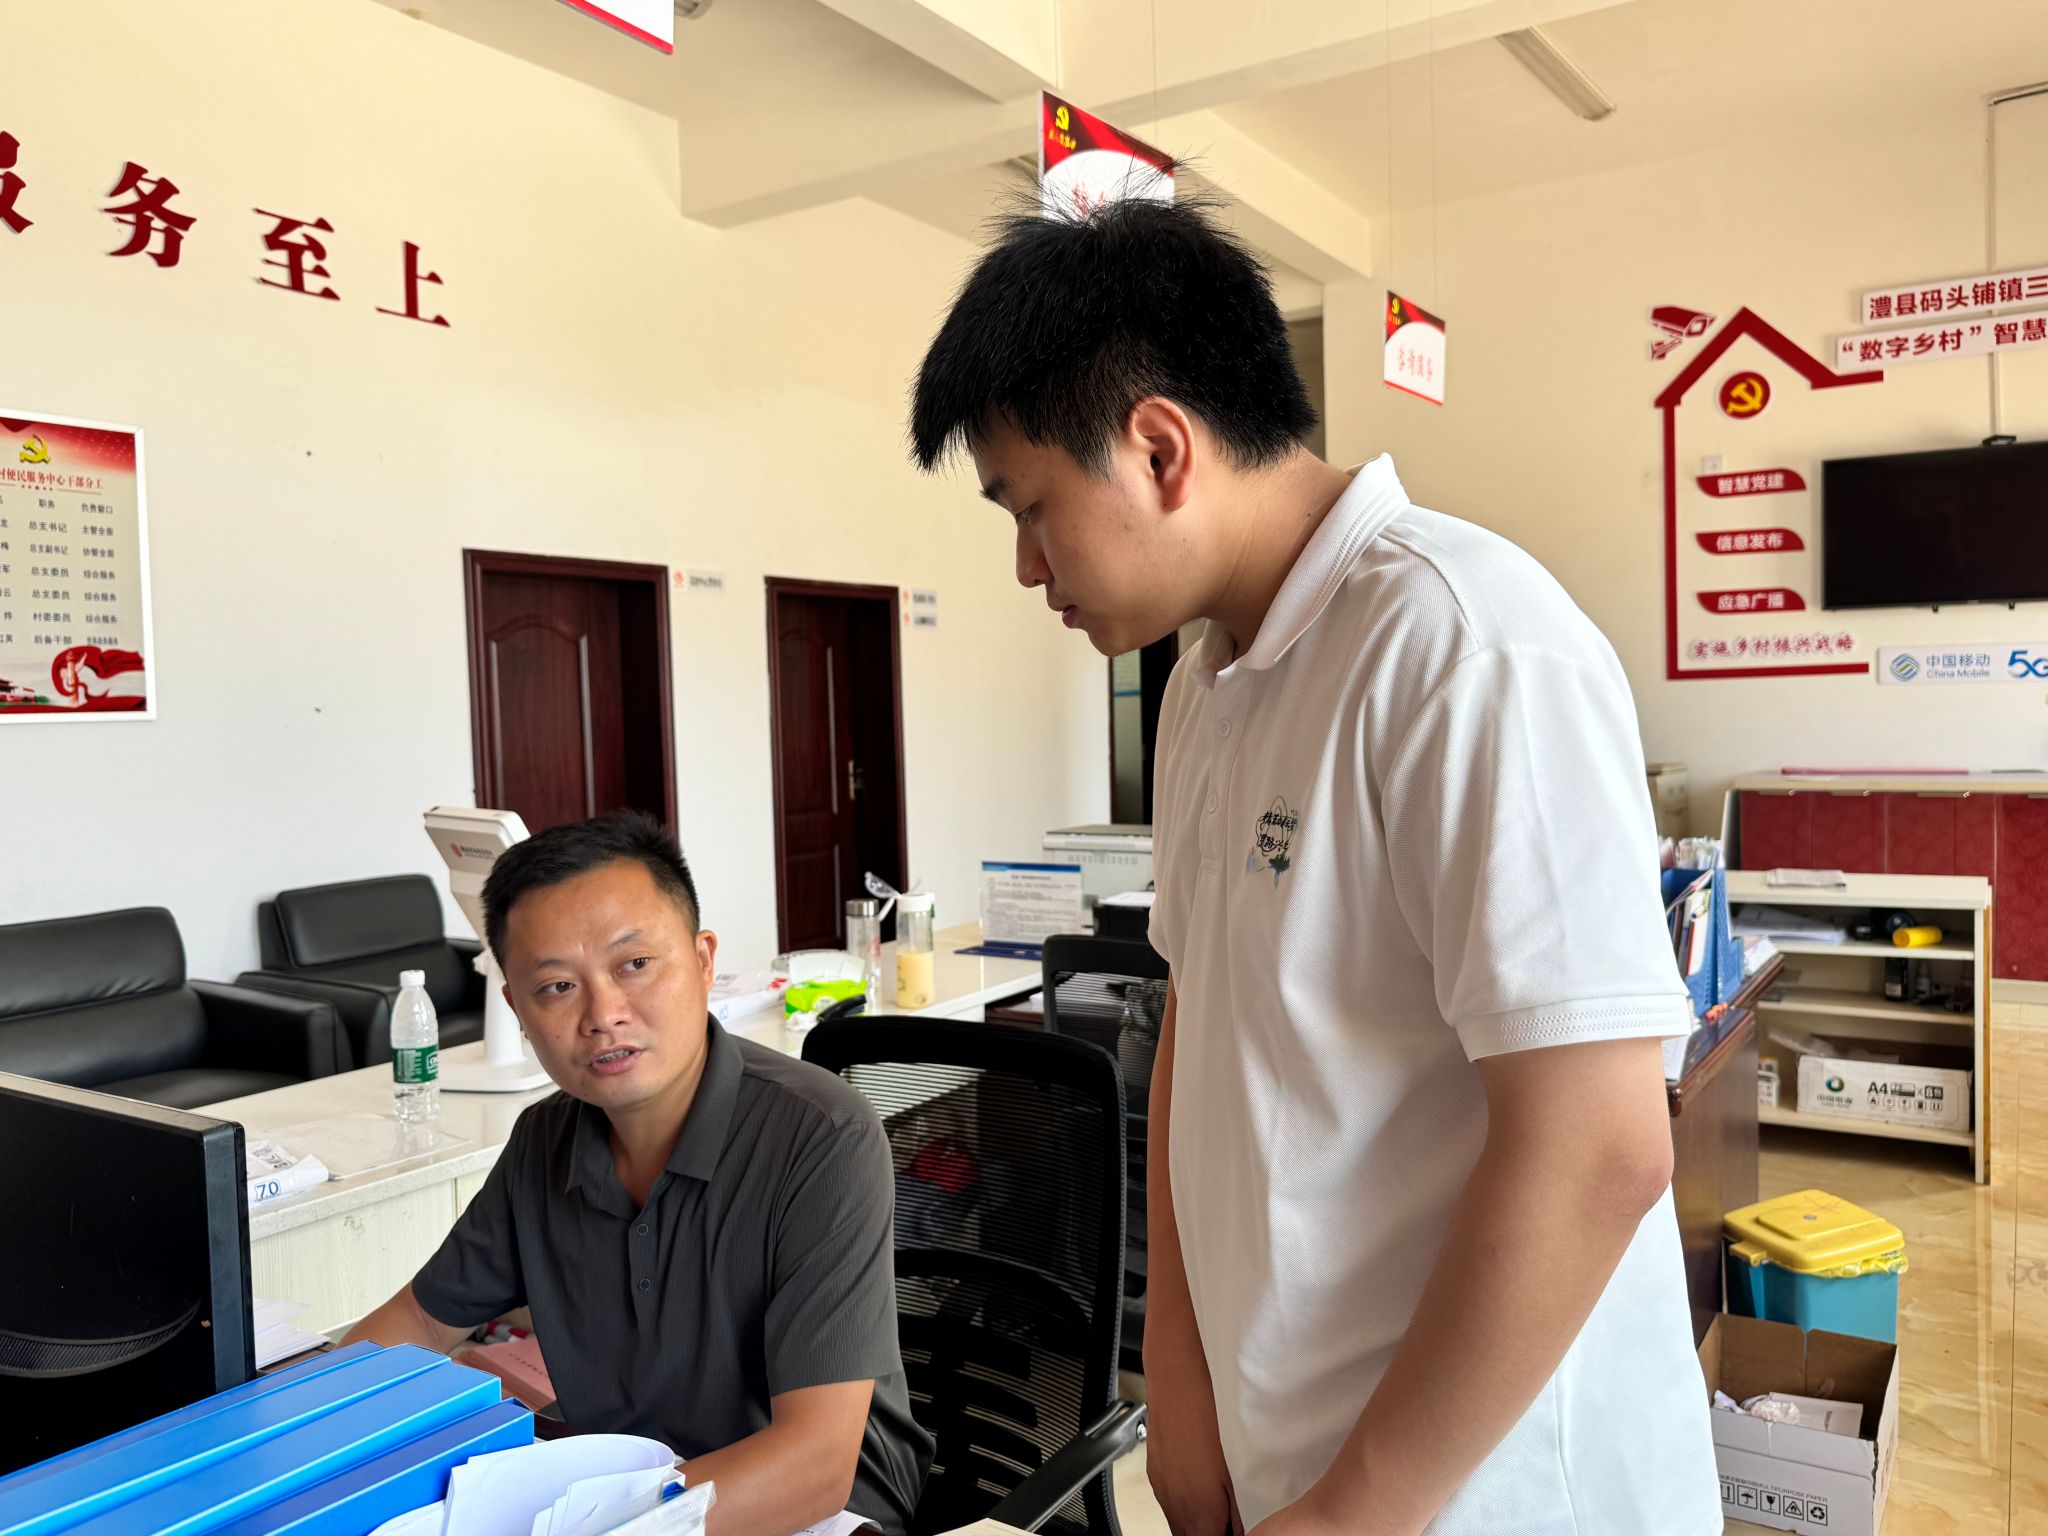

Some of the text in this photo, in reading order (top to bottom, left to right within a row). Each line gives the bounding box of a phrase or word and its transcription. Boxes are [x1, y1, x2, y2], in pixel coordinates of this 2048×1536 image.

[1869, 275, 2048, 320] 澧县码头铺镇三
[1717, 472, 1785, 494] 智慧党建
[39, 498, 55, 510] 职务
[29, 520, 68, 533] 总支书记
[1716, 532, 1783, 552] 信息发布
[1717, 591, 1785, 611] 应急广播
[1926, 653, 1990, 668] 中国移动
[1926, 668, 1990, 679] China Mobile
[1868, 1081, 1888, 1096] A4
